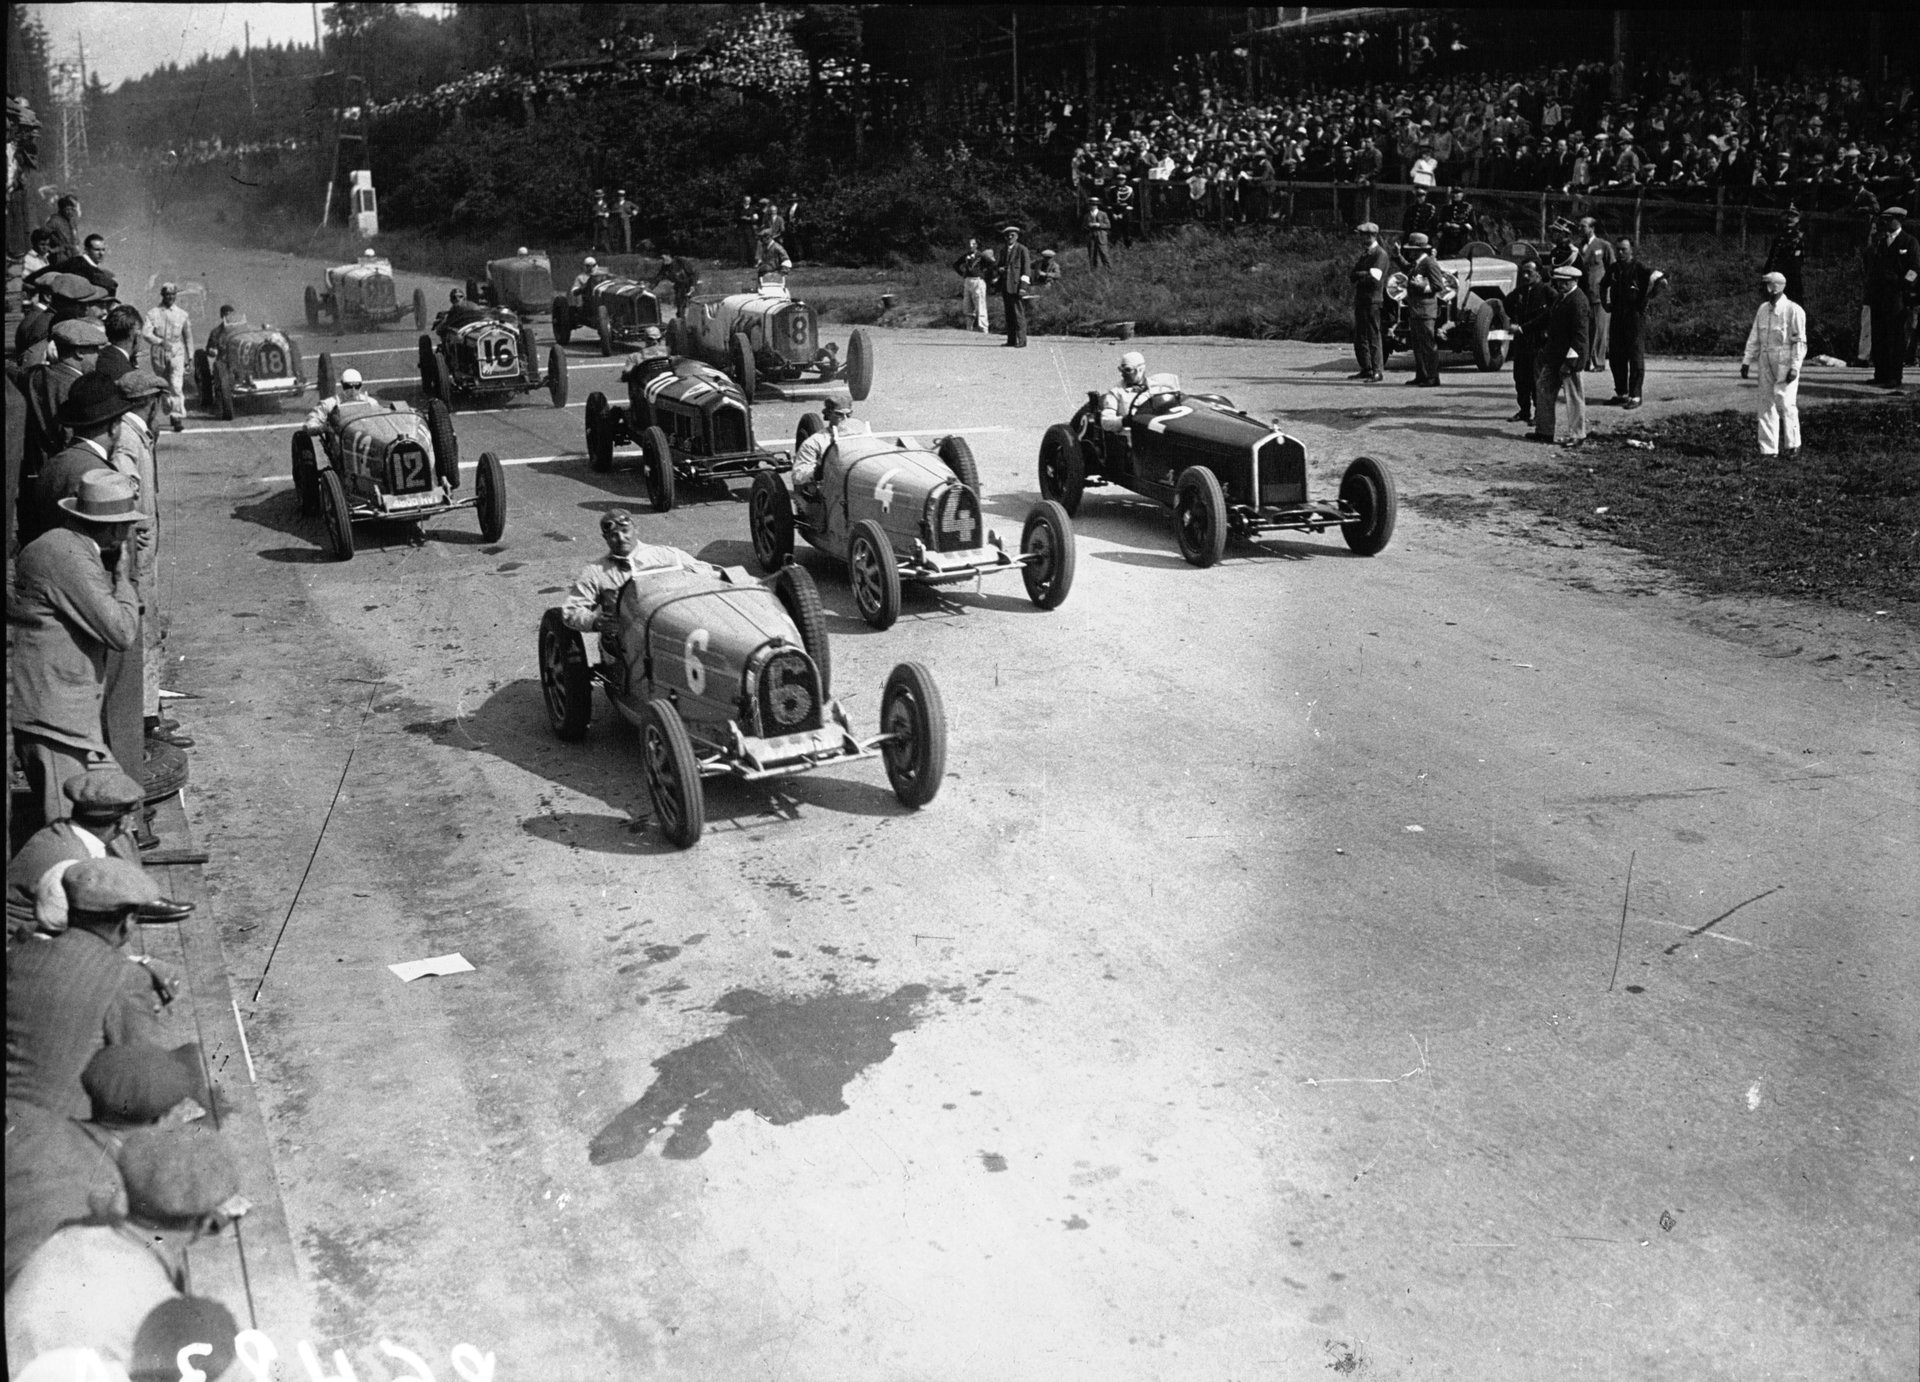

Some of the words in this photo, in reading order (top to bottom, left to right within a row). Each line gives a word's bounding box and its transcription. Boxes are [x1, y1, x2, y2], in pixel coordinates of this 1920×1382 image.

[792, 316, 807, 345] 8
[260, 350, 283, 374] 18
[484, 338, 515, 368] 16
[1147, 405, 1194, 434] 2
[352, 430, 372, 478] 12
[393, 451, 426, 490] 12
[874, 467, 903, 514] 4
[941, 486, 976, 542] 4
[685, 628, 710, 696] 6
[768, 656, 813, 725] 6
